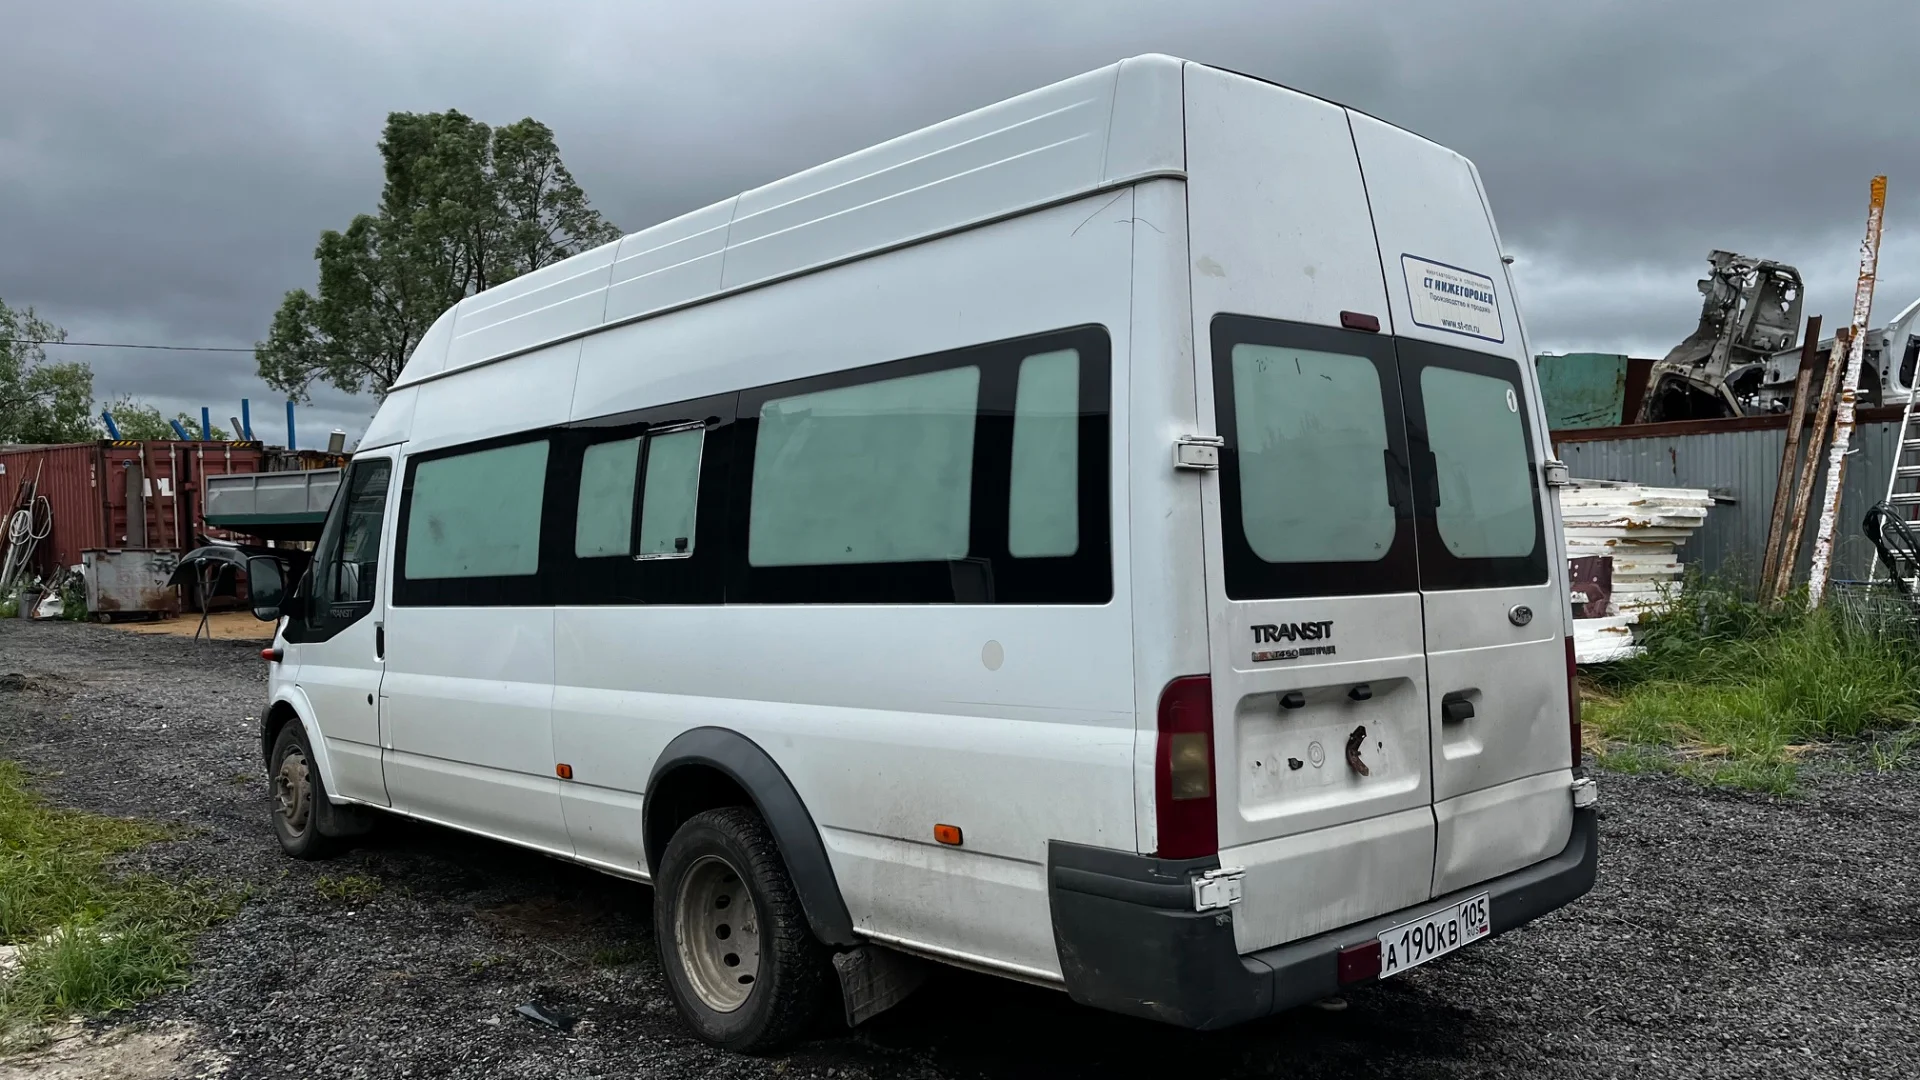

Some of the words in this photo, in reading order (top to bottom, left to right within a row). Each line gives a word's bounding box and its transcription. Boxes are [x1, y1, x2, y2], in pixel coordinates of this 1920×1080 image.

[1424, 277, 1433, 289] СТ
[1434, 279, 1493, 305] НИЖЕГОРОДЕЦ
[329, 608, 354, 618] TRANSIT
[1250, 620, 1334, 643] TRANSIT
[1461, 898, 1486, 930] 105
[1466, 925, 1480, 938] RUS
